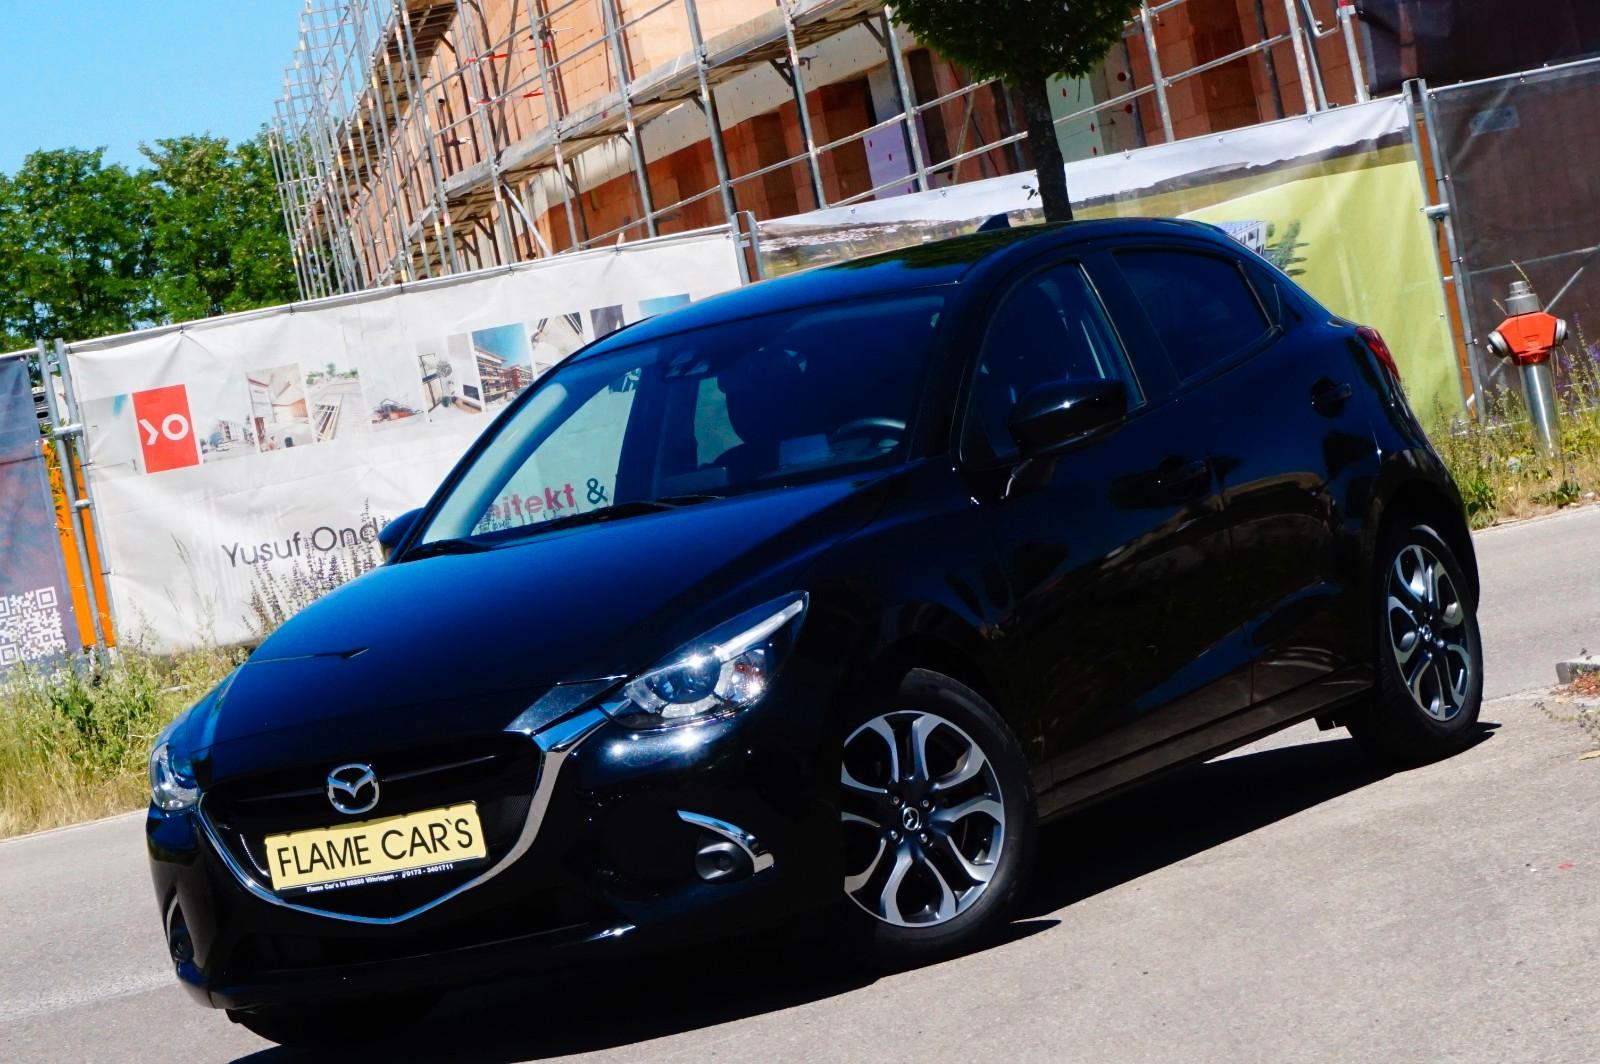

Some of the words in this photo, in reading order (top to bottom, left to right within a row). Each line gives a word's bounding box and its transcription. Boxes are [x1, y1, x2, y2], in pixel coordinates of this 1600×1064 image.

[221, 531, 301, 568] Yusuf
[587, 478, 608, 505] &
[277, 834, 371, 877] FLAME
[306, 885, 324, 893] Flame
